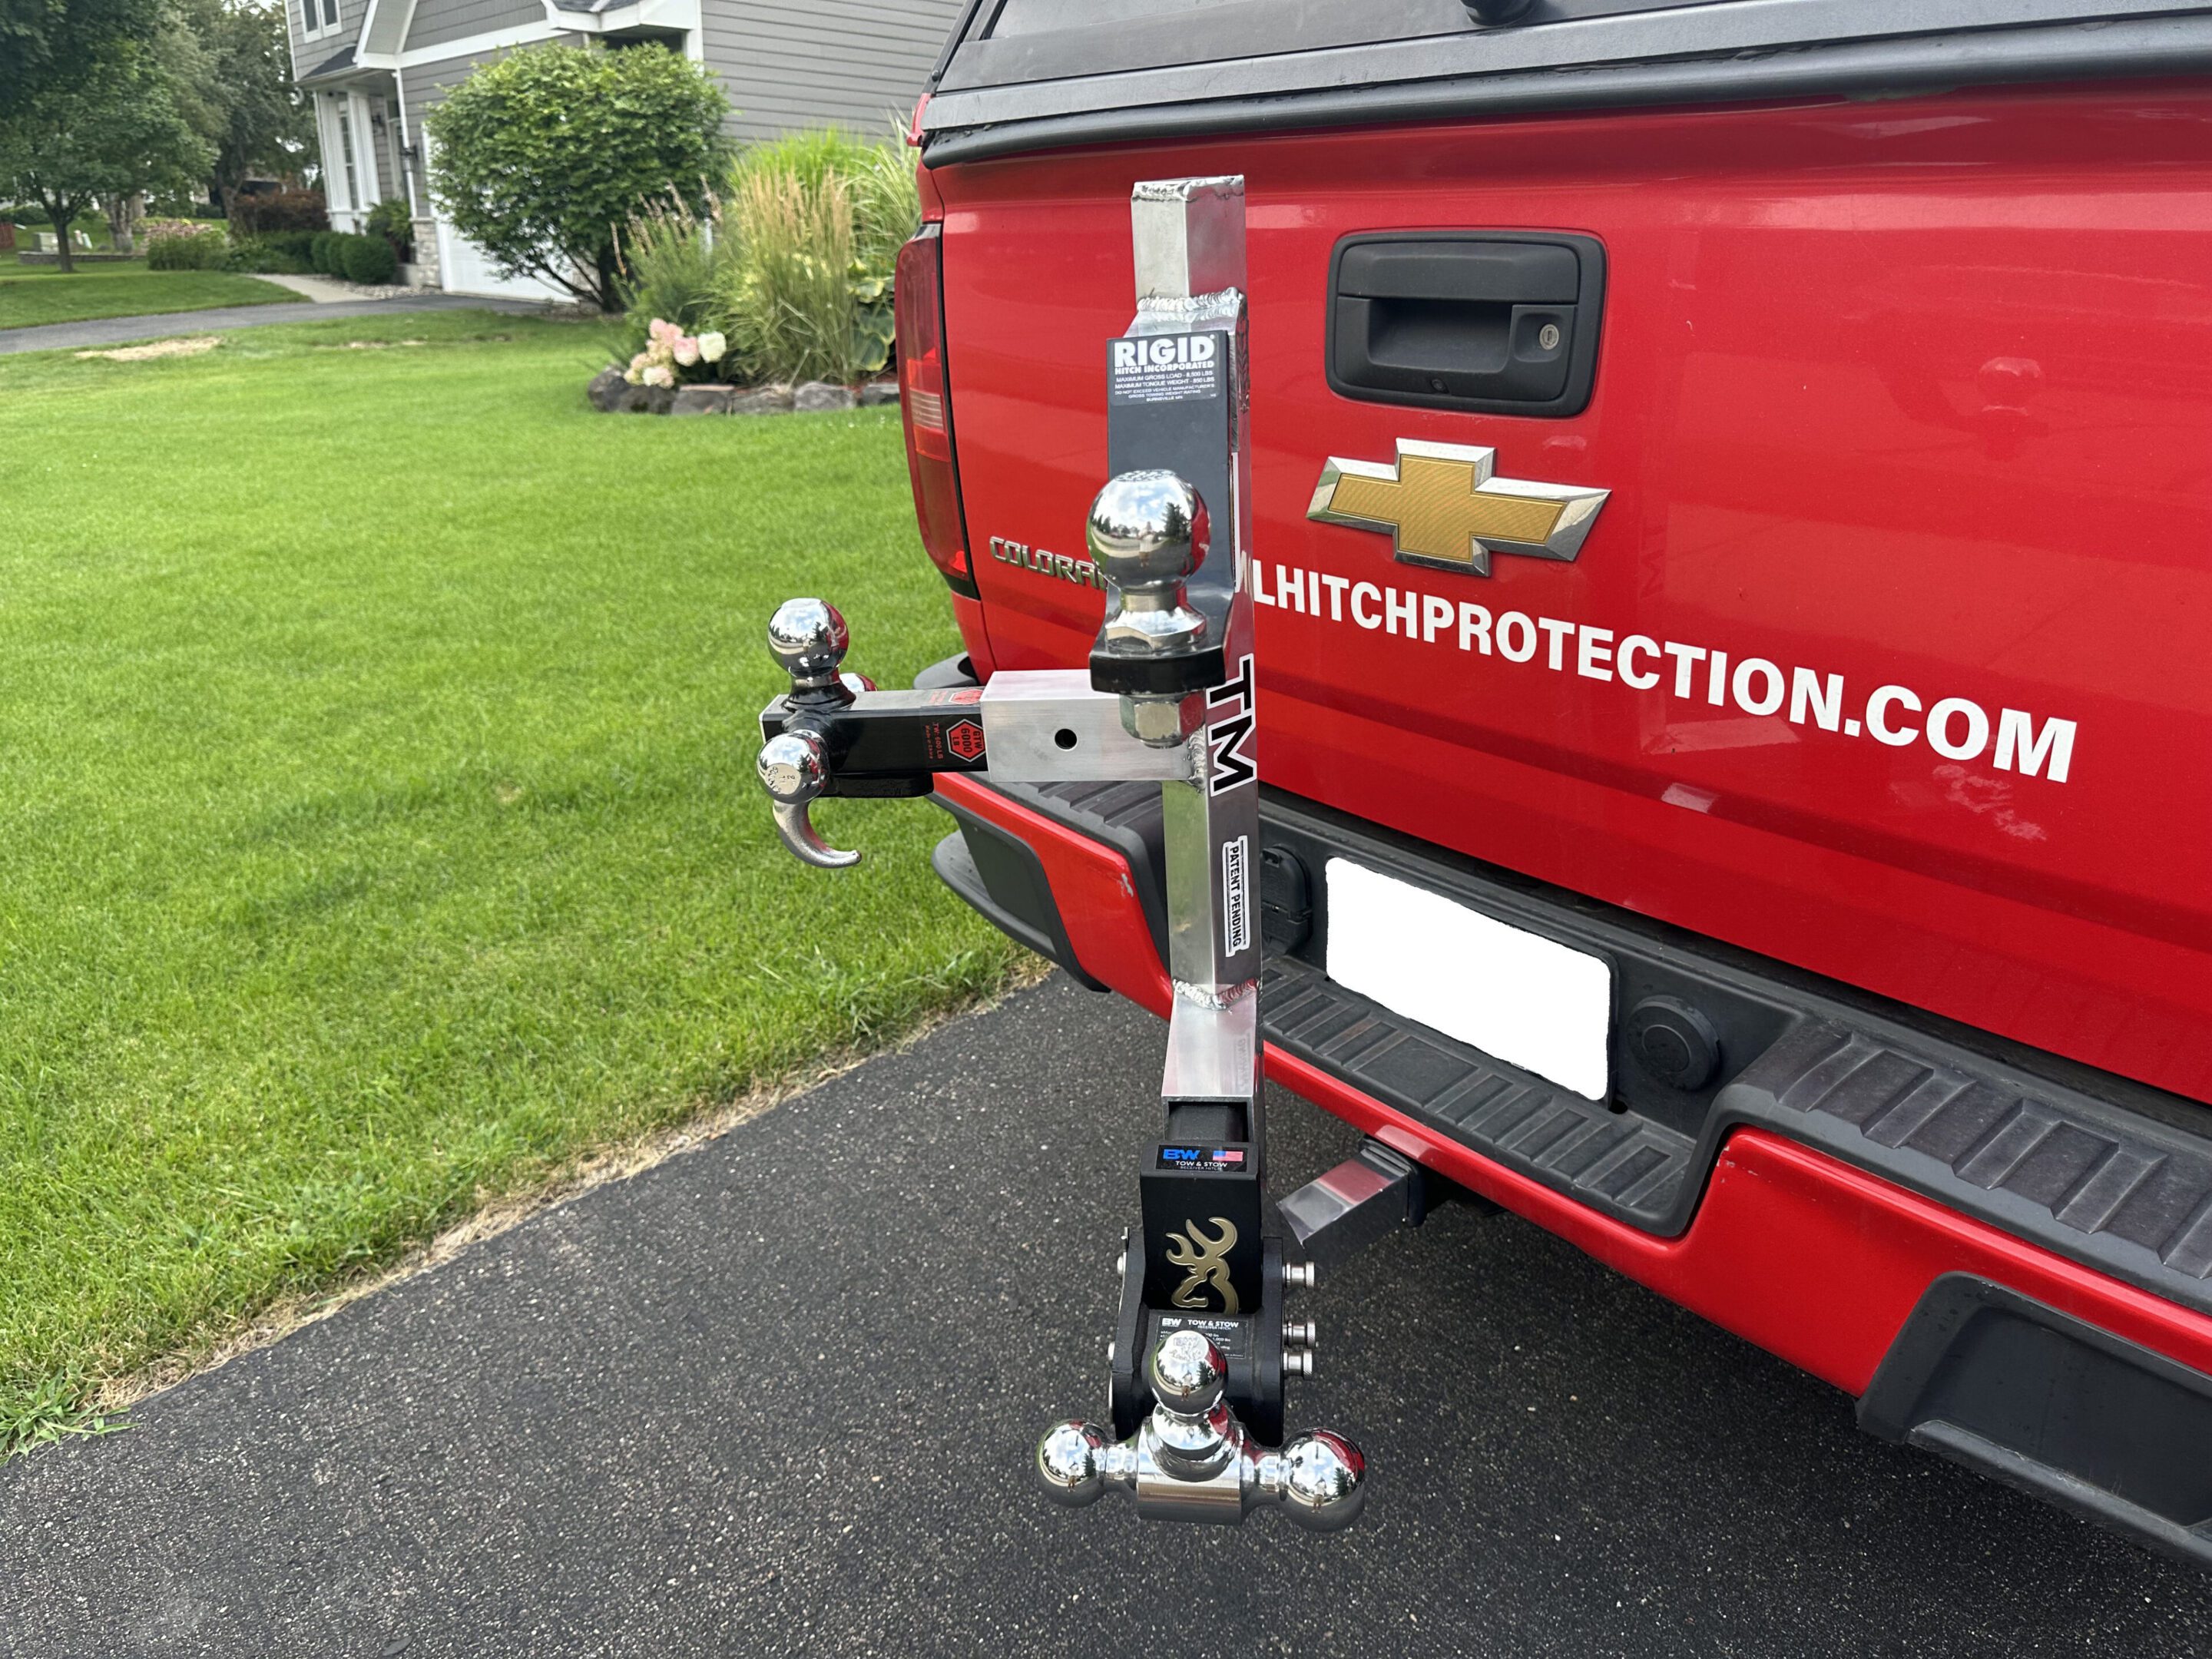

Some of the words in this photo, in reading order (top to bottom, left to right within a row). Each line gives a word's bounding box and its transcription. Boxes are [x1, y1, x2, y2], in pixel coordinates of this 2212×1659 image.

[1114, 336, 1214, 367] RIGID
[1115, 366, 1141, 375] HITCH
[1144, 361, 1214, 373] INCORPORATED
[1253, 559, 2078, 783] LHITCHPROTECTION.COM
[961, 727, 972, 753] 6000
[972, 730, 983, 750] GTW
[1207, 655, 1256, 795] TM
[1230, 846, 1240, 891] PATENT
[1231, 894, 1242, 947] PENDING
